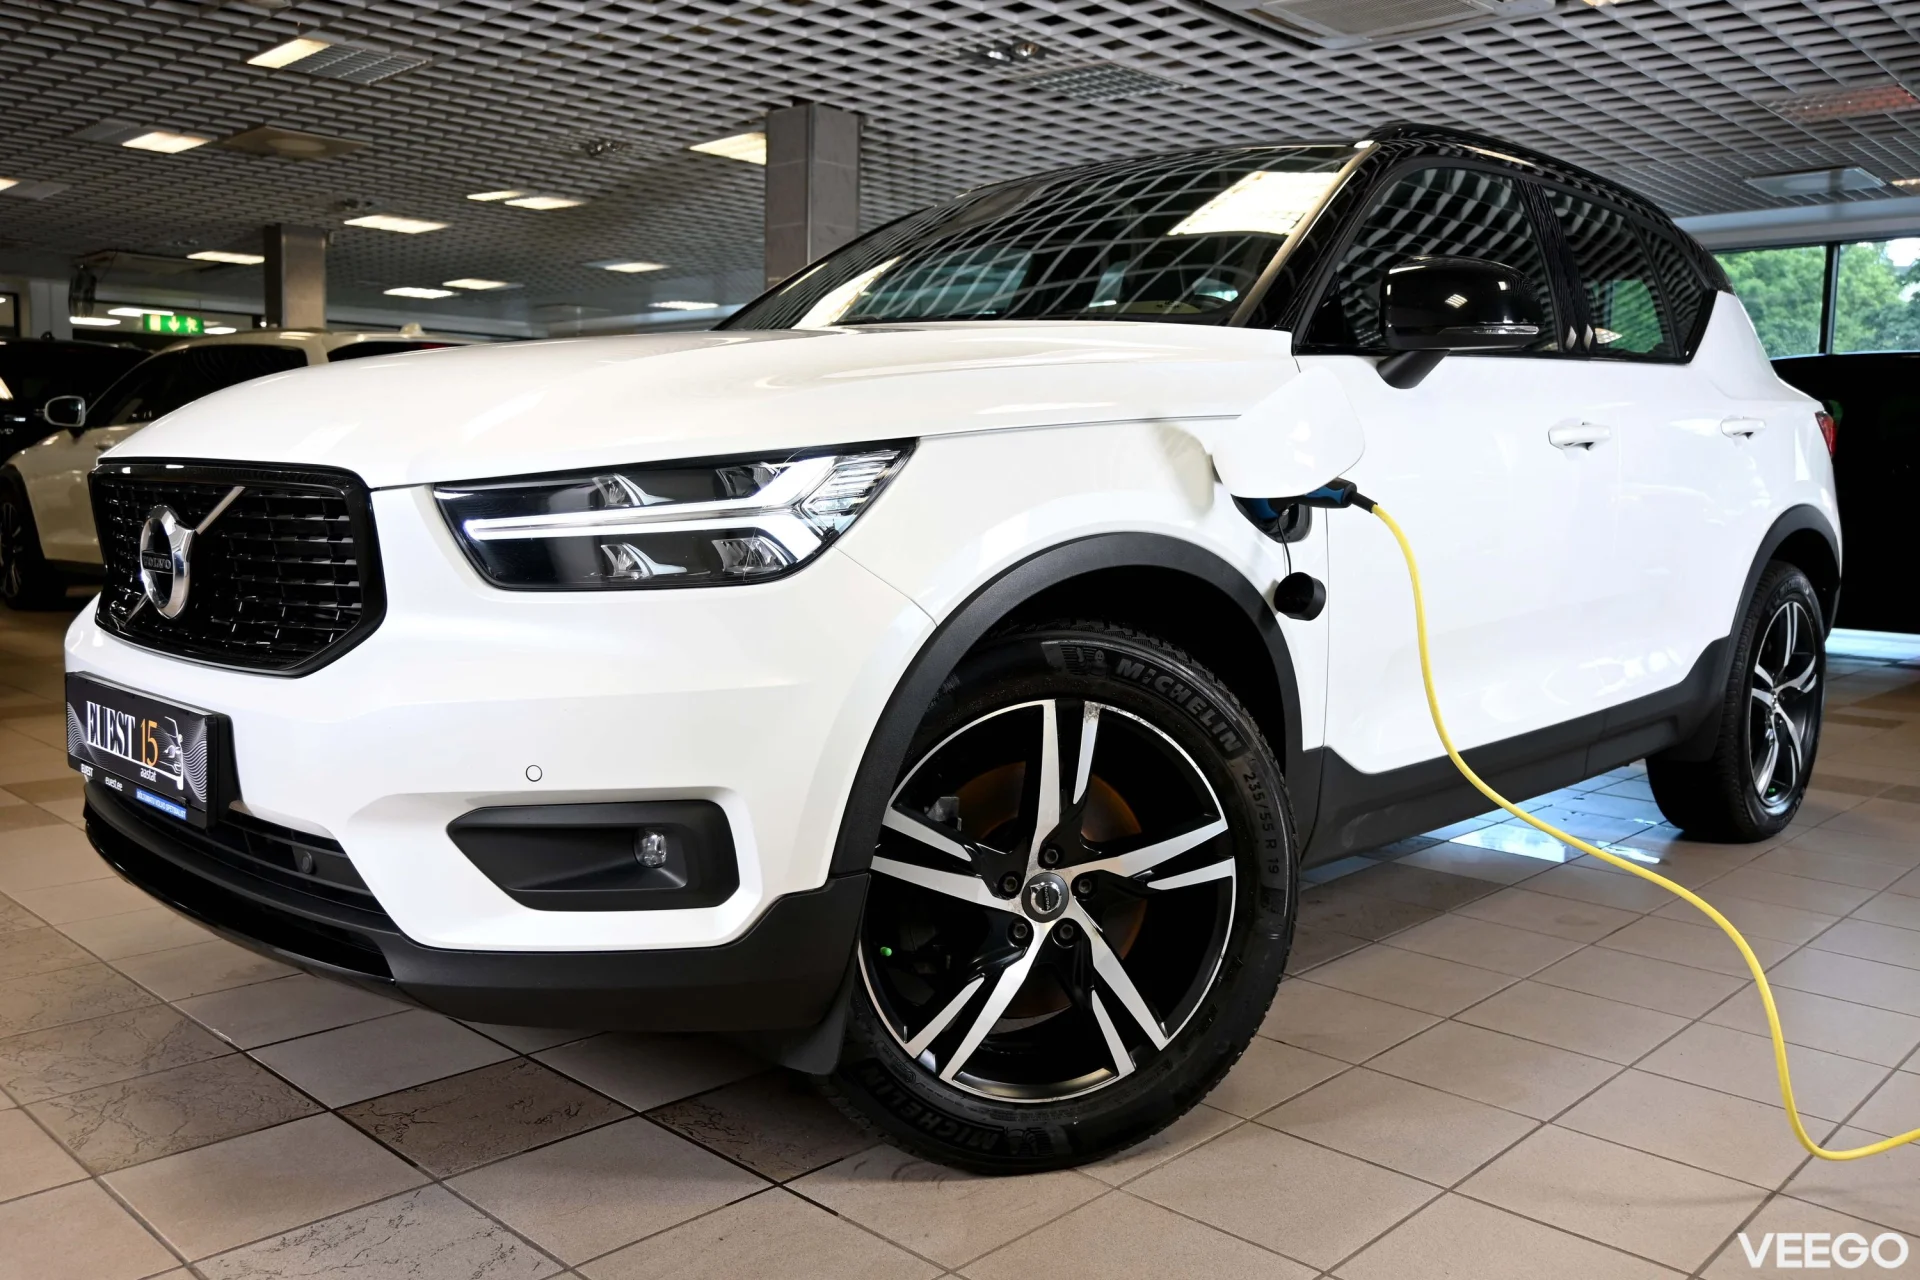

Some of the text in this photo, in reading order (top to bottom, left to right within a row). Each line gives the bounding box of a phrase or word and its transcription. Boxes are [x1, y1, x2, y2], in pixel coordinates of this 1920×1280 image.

[142, 555, 172, 570] VOLVO
[1114, 657, 1243, 752] MICHELIN
[140, 717, 159, 767] 15
[1243, 771, 1275, 832] 235/55
[1265, 838, 1278, 850] R
[1267, 857, 1280, 875] 19
[859, 1065, 1001, 1151] MICHELIN
